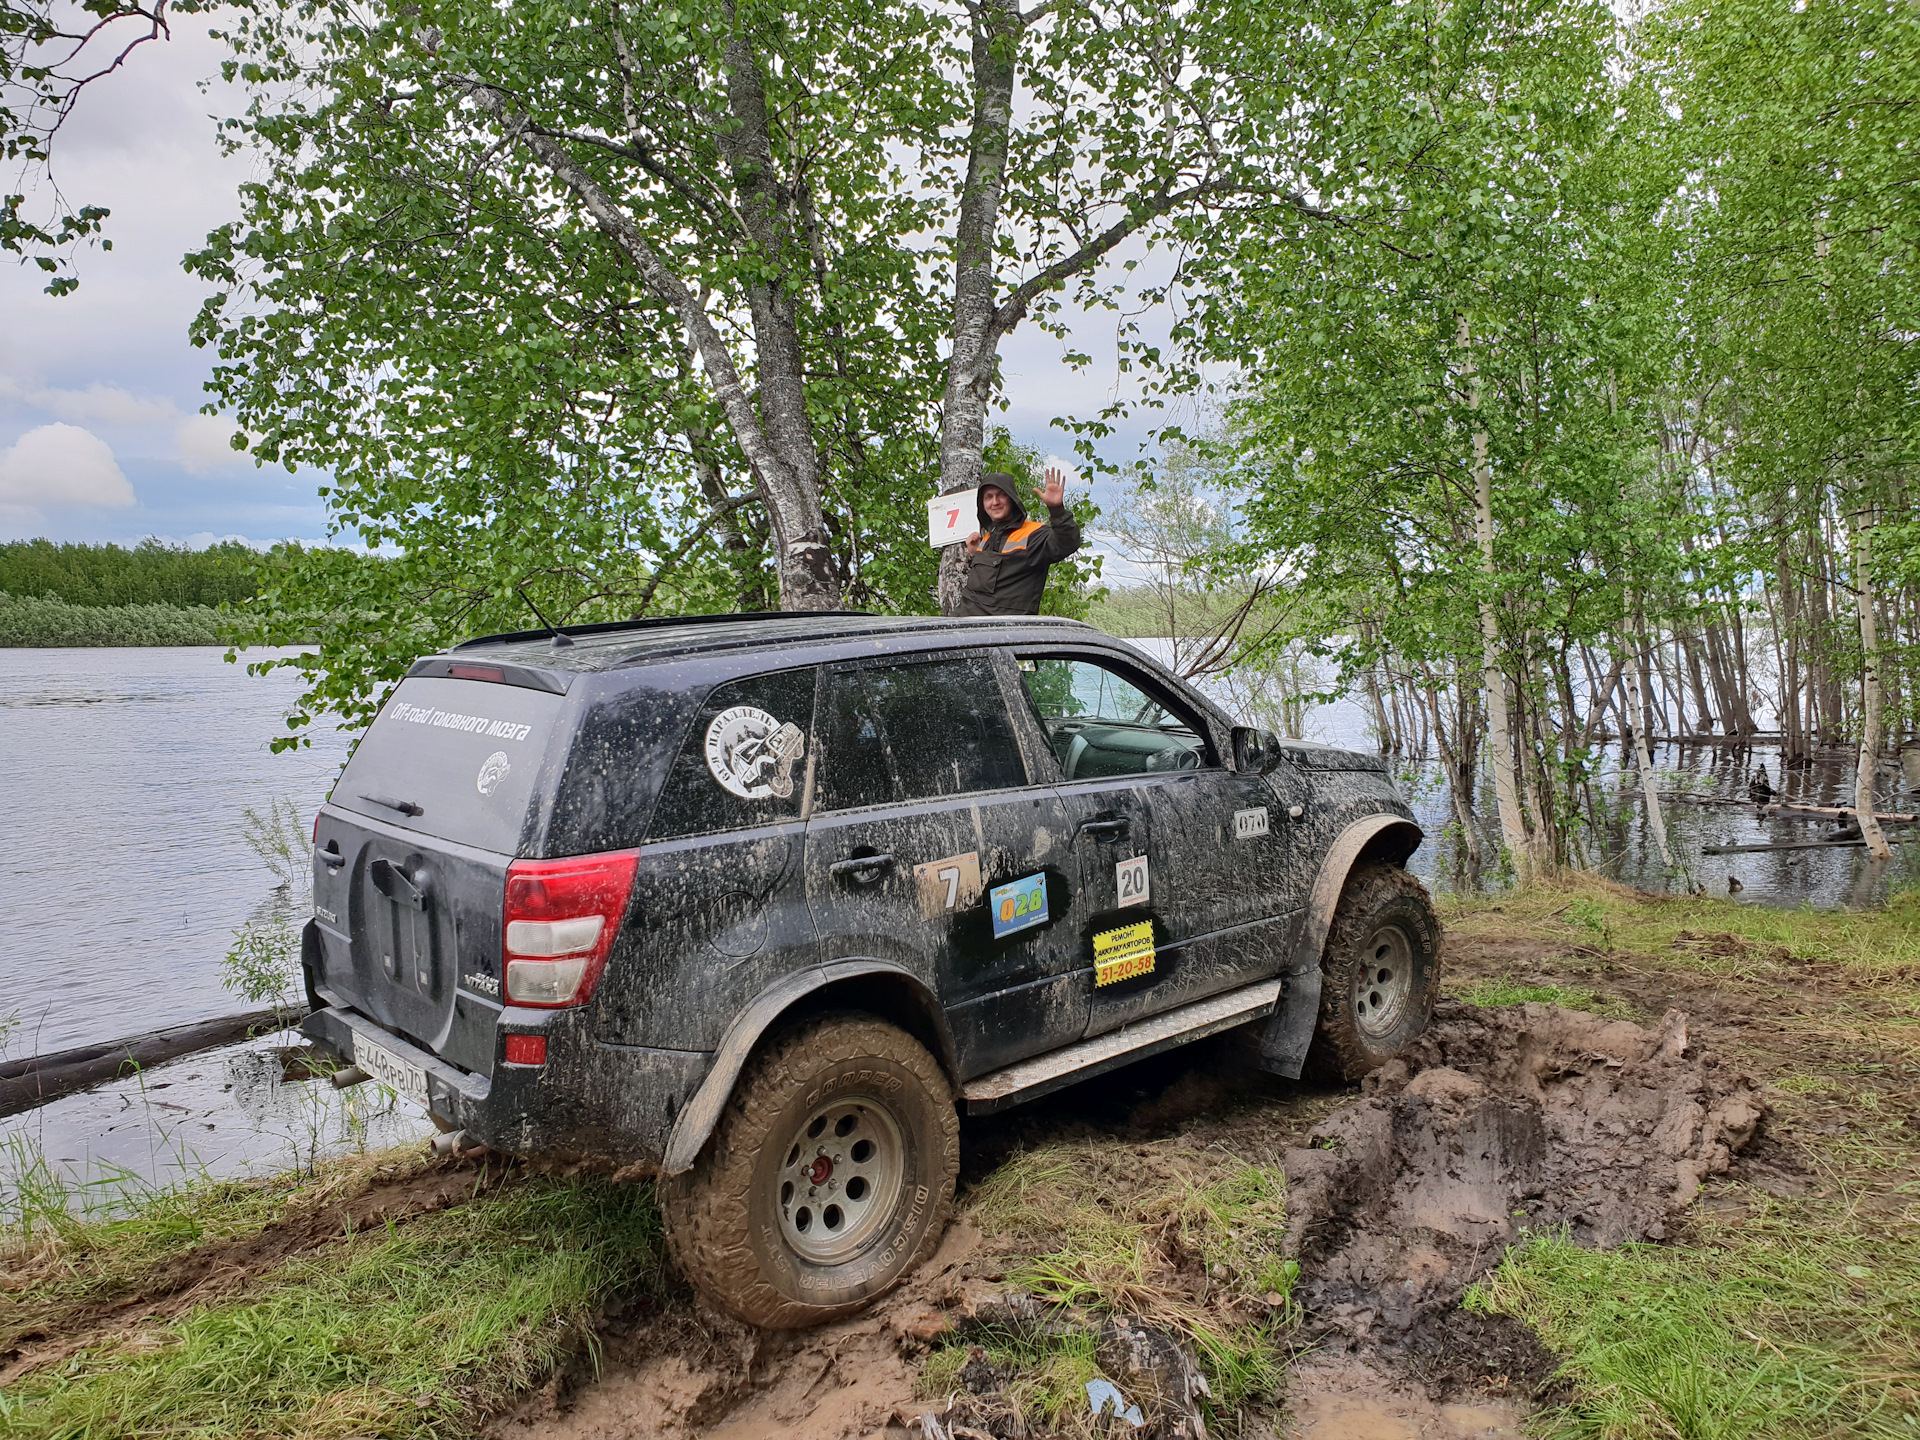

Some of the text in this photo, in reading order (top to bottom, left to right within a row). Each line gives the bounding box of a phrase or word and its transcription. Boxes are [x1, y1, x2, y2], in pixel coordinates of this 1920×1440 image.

[946, 508, 960, 529] 7
[389, 702, 532, 741] Off-road головного мозга
[708, 707, 773, 748] ПАРАЛЛЕЛЬ
[1239, 813, 1266, 833] 070
[937, 865, 960, 911] 7
[1121, 866, 1144, 898] 20
[1000, 888, 1043, 922] 028
[1110, 930, 1135, 942] РЕМОНТ
[1101, 955, 1152, 982] 51-20-58
[407, 1067, 422, 1094] 70
[805, 1070, 902, 1109] COOPER
[799, 1184, 930, 1292] DISCOVERER
